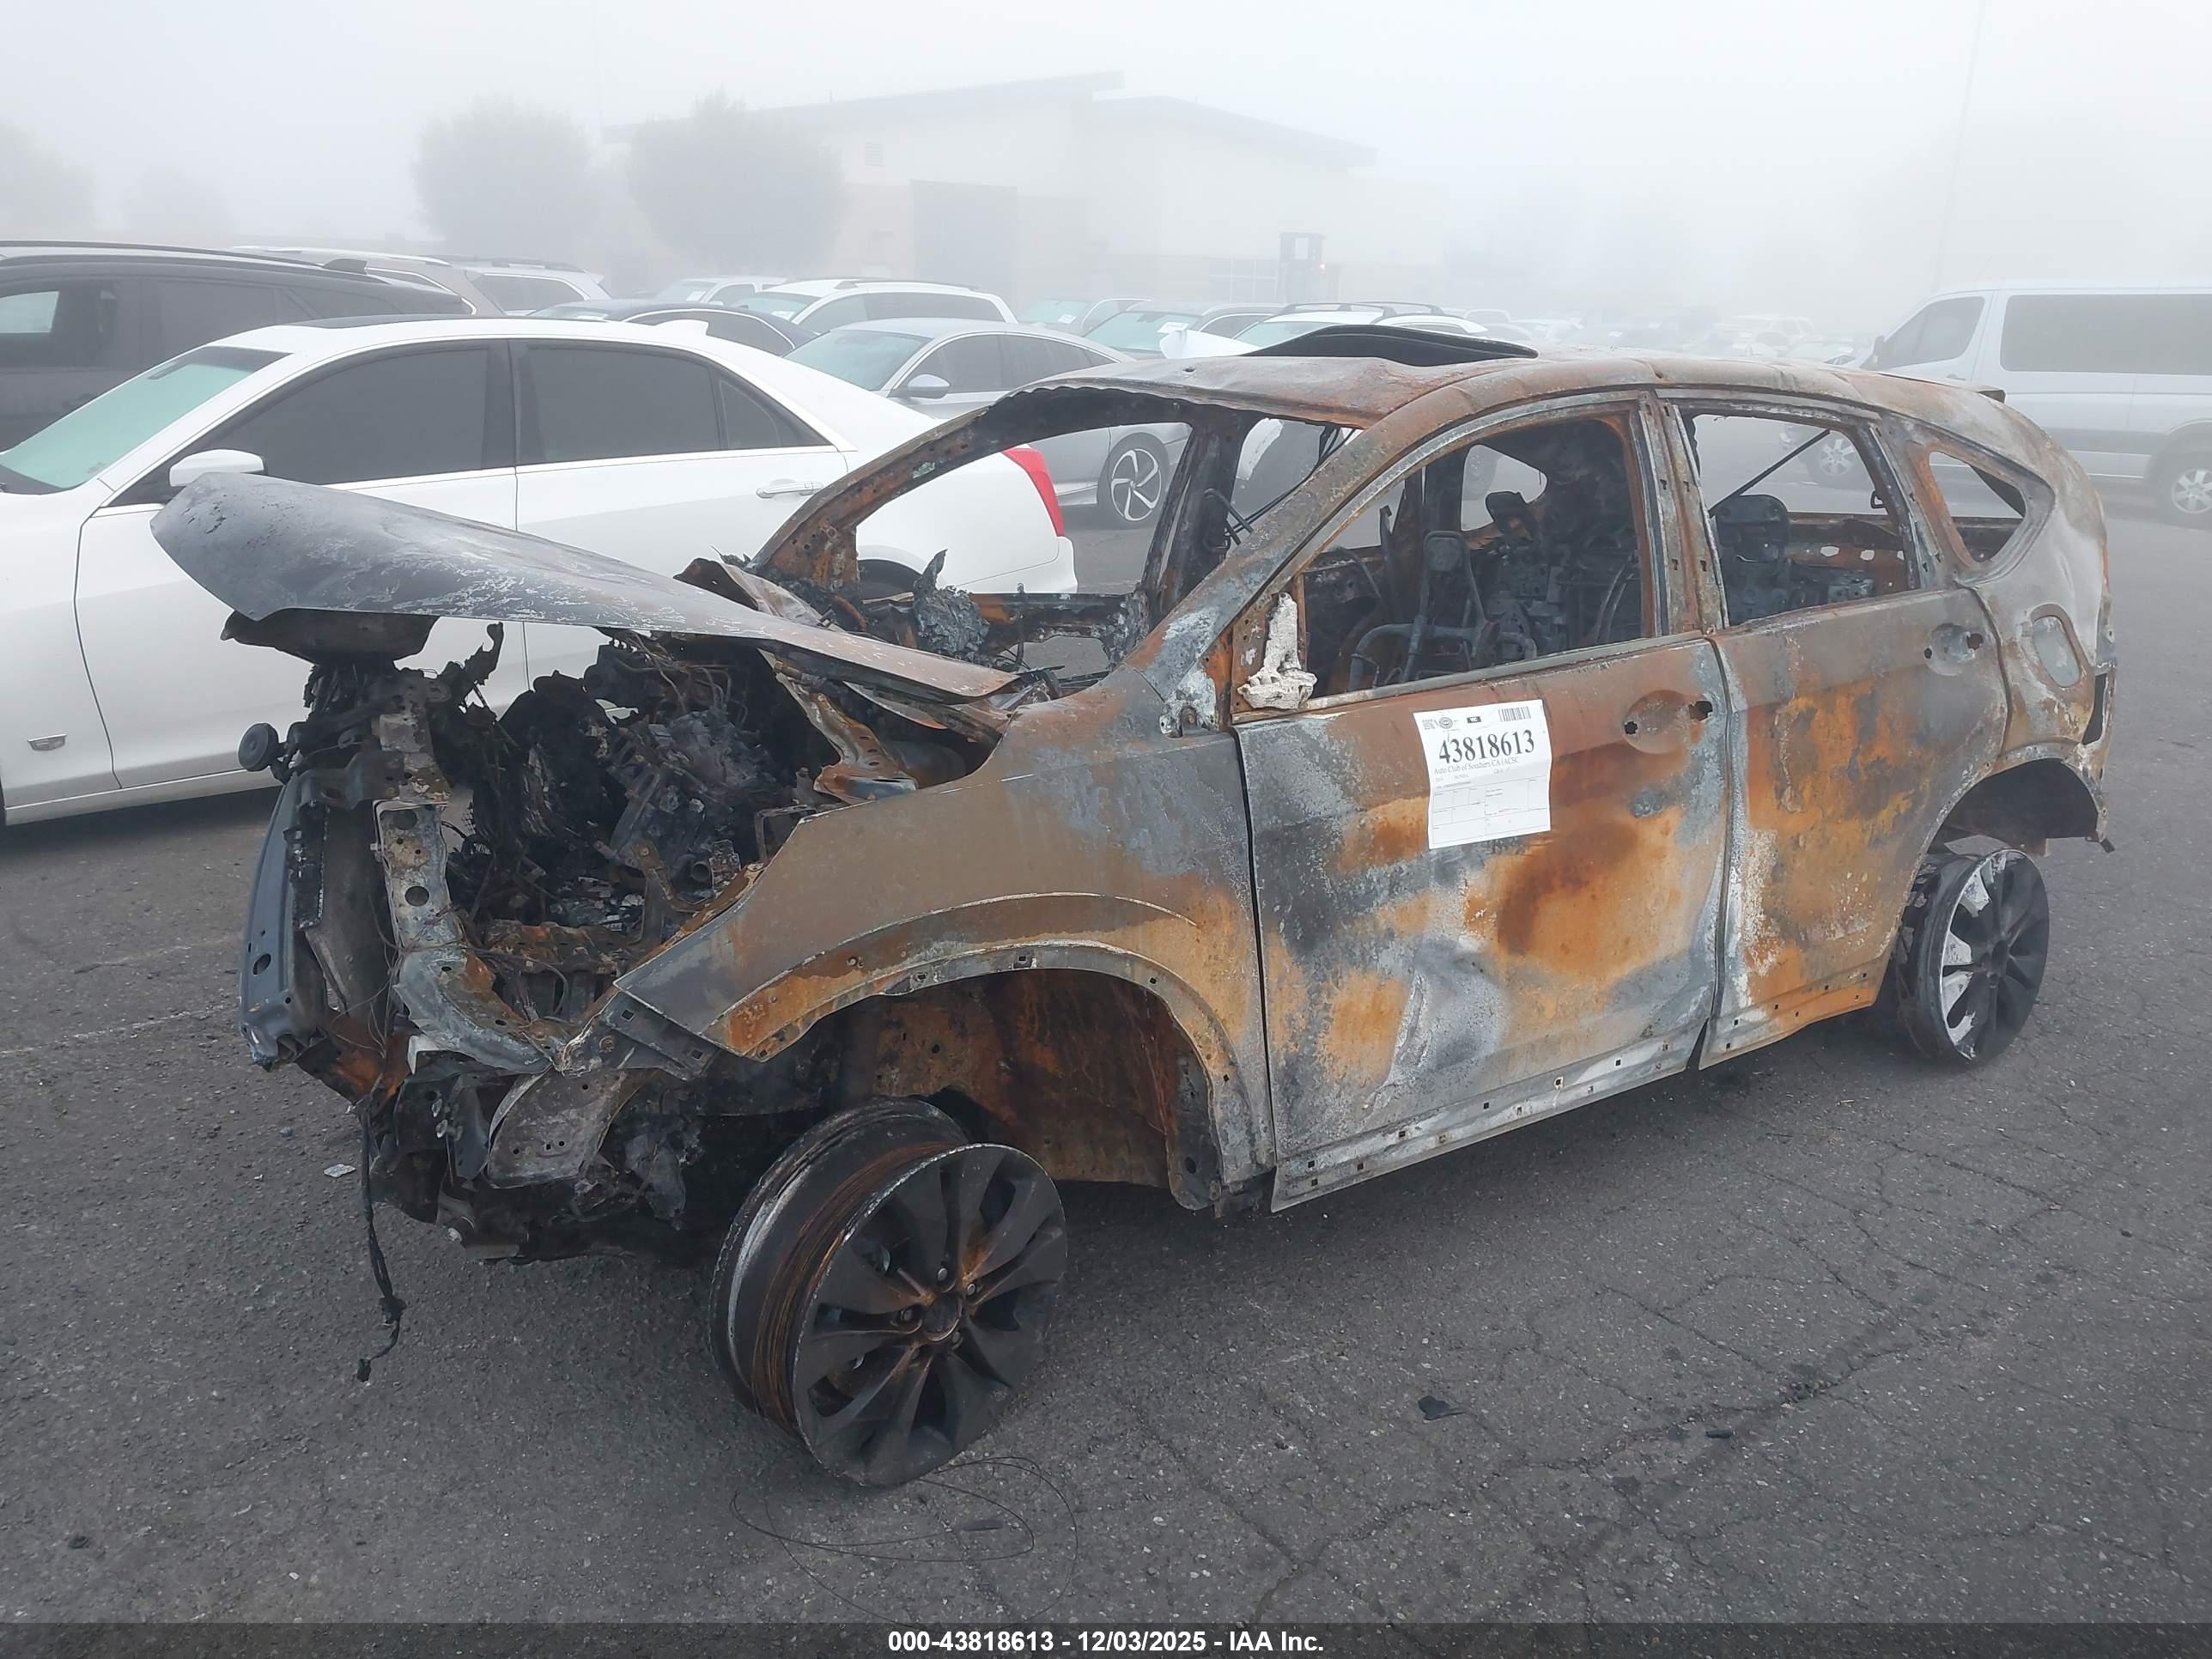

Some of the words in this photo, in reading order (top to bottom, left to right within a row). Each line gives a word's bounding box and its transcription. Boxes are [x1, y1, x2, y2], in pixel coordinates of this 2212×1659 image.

[1439, 729, 1534, 763] 43818613
[1448, 763, 1462, 774] Club
[1462, 762, 1469, 771] of
